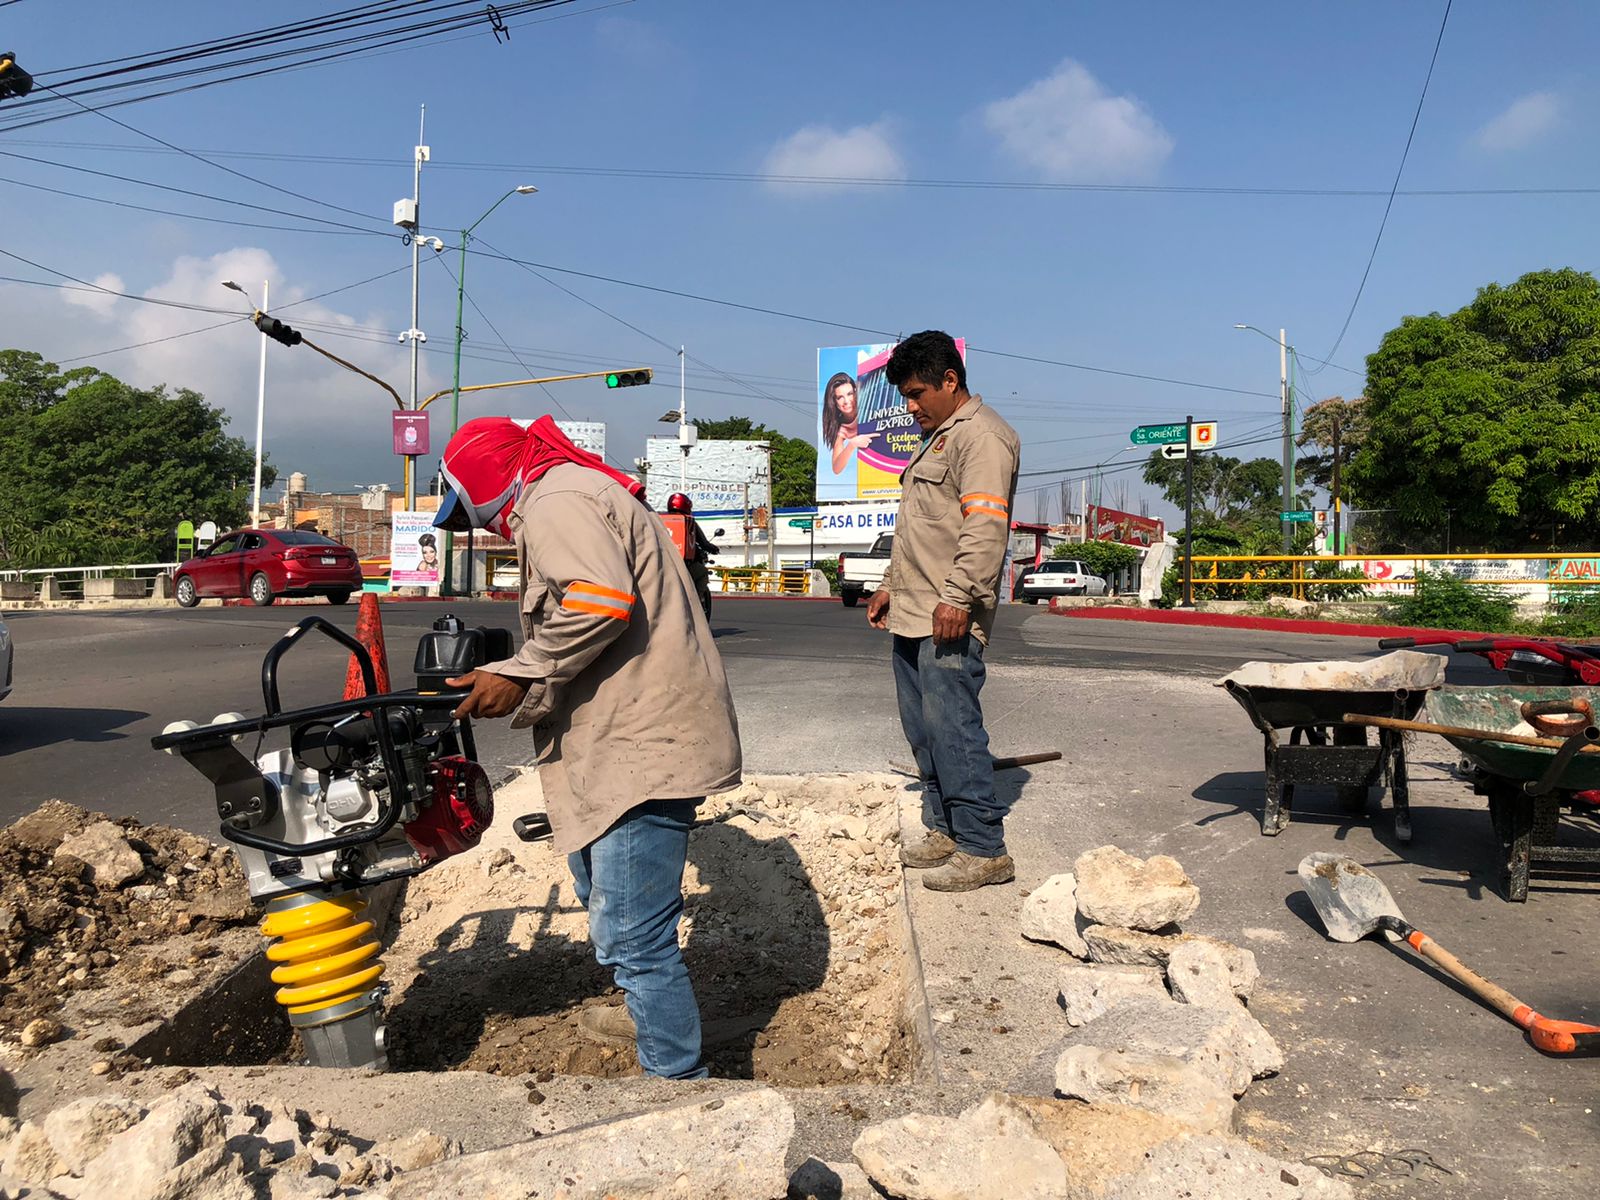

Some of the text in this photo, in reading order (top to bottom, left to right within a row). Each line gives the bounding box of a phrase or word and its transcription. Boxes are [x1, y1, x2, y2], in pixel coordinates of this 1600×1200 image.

[868, 404, 909, 422] UNIVERSI
[1148, 431, 1182, 439] ORIENTE
[671, 483, 745, 492] DISPONIBLE
[822, 513, 853, 529] CASA
[857, 513, 873, 527] DE
[876, 512, 898, 527] EM
[395, 525, 436, 533] MARIDO
